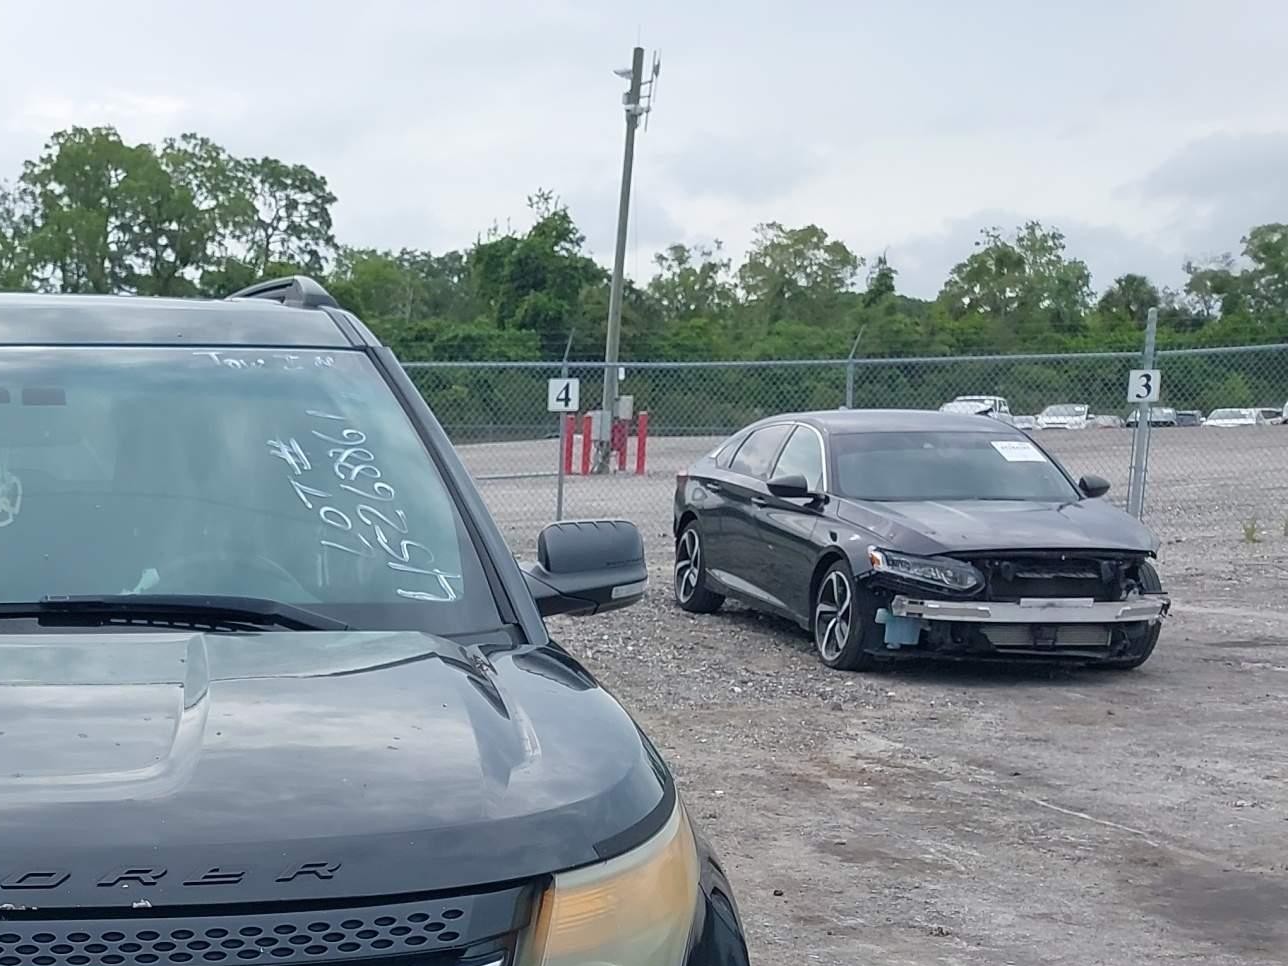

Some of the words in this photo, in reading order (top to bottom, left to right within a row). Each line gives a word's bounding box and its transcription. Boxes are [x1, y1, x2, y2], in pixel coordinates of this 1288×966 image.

[556, 382, 572, 408] 4
[1136, 373, 1152, 399] 3
[305, 409, 461, 602] 45268861
